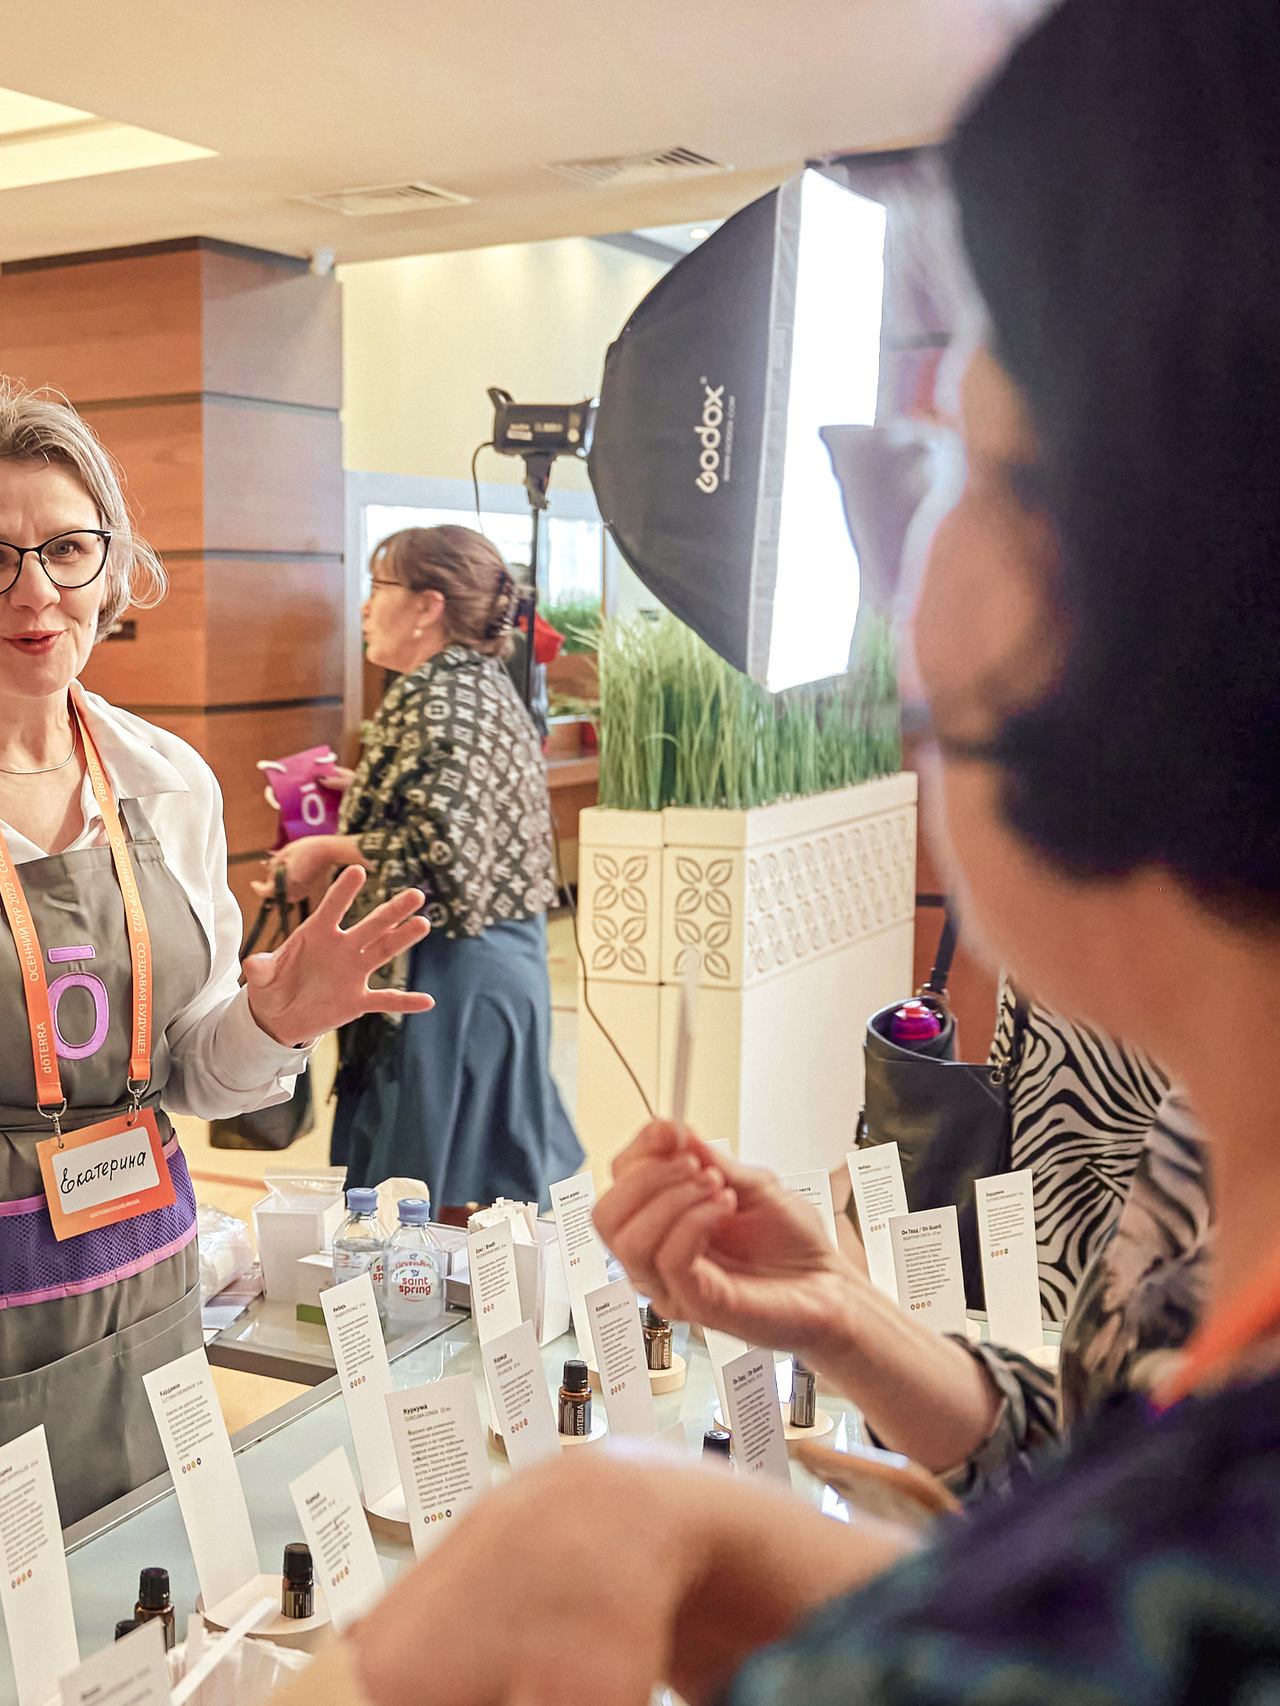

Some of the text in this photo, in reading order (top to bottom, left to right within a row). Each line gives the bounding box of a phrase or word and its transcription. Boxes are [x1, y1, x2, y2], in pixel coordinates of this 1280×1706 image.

[694, 384, 725, 494] Godox
[4, 881, 20, 905] 2022
[126, 889, 138, 909] ТУР
[14, 906, 28, 928] ТУР
[130, 909, 143, 933] 2022
[18, 928, 40, 982] ОСЕННИЙ
[136, 942, 147, 1004] СОЗДАВАЯ
[137, 1004, 147, 1055] БУДУЩЕЕ
[60, 1151, 147, 1195] Екатерина
[398, 1284, 432, 1296] spring
[402, 1276, 428, 1285] saint
[403, 1403, 428, 1415] Куркума
